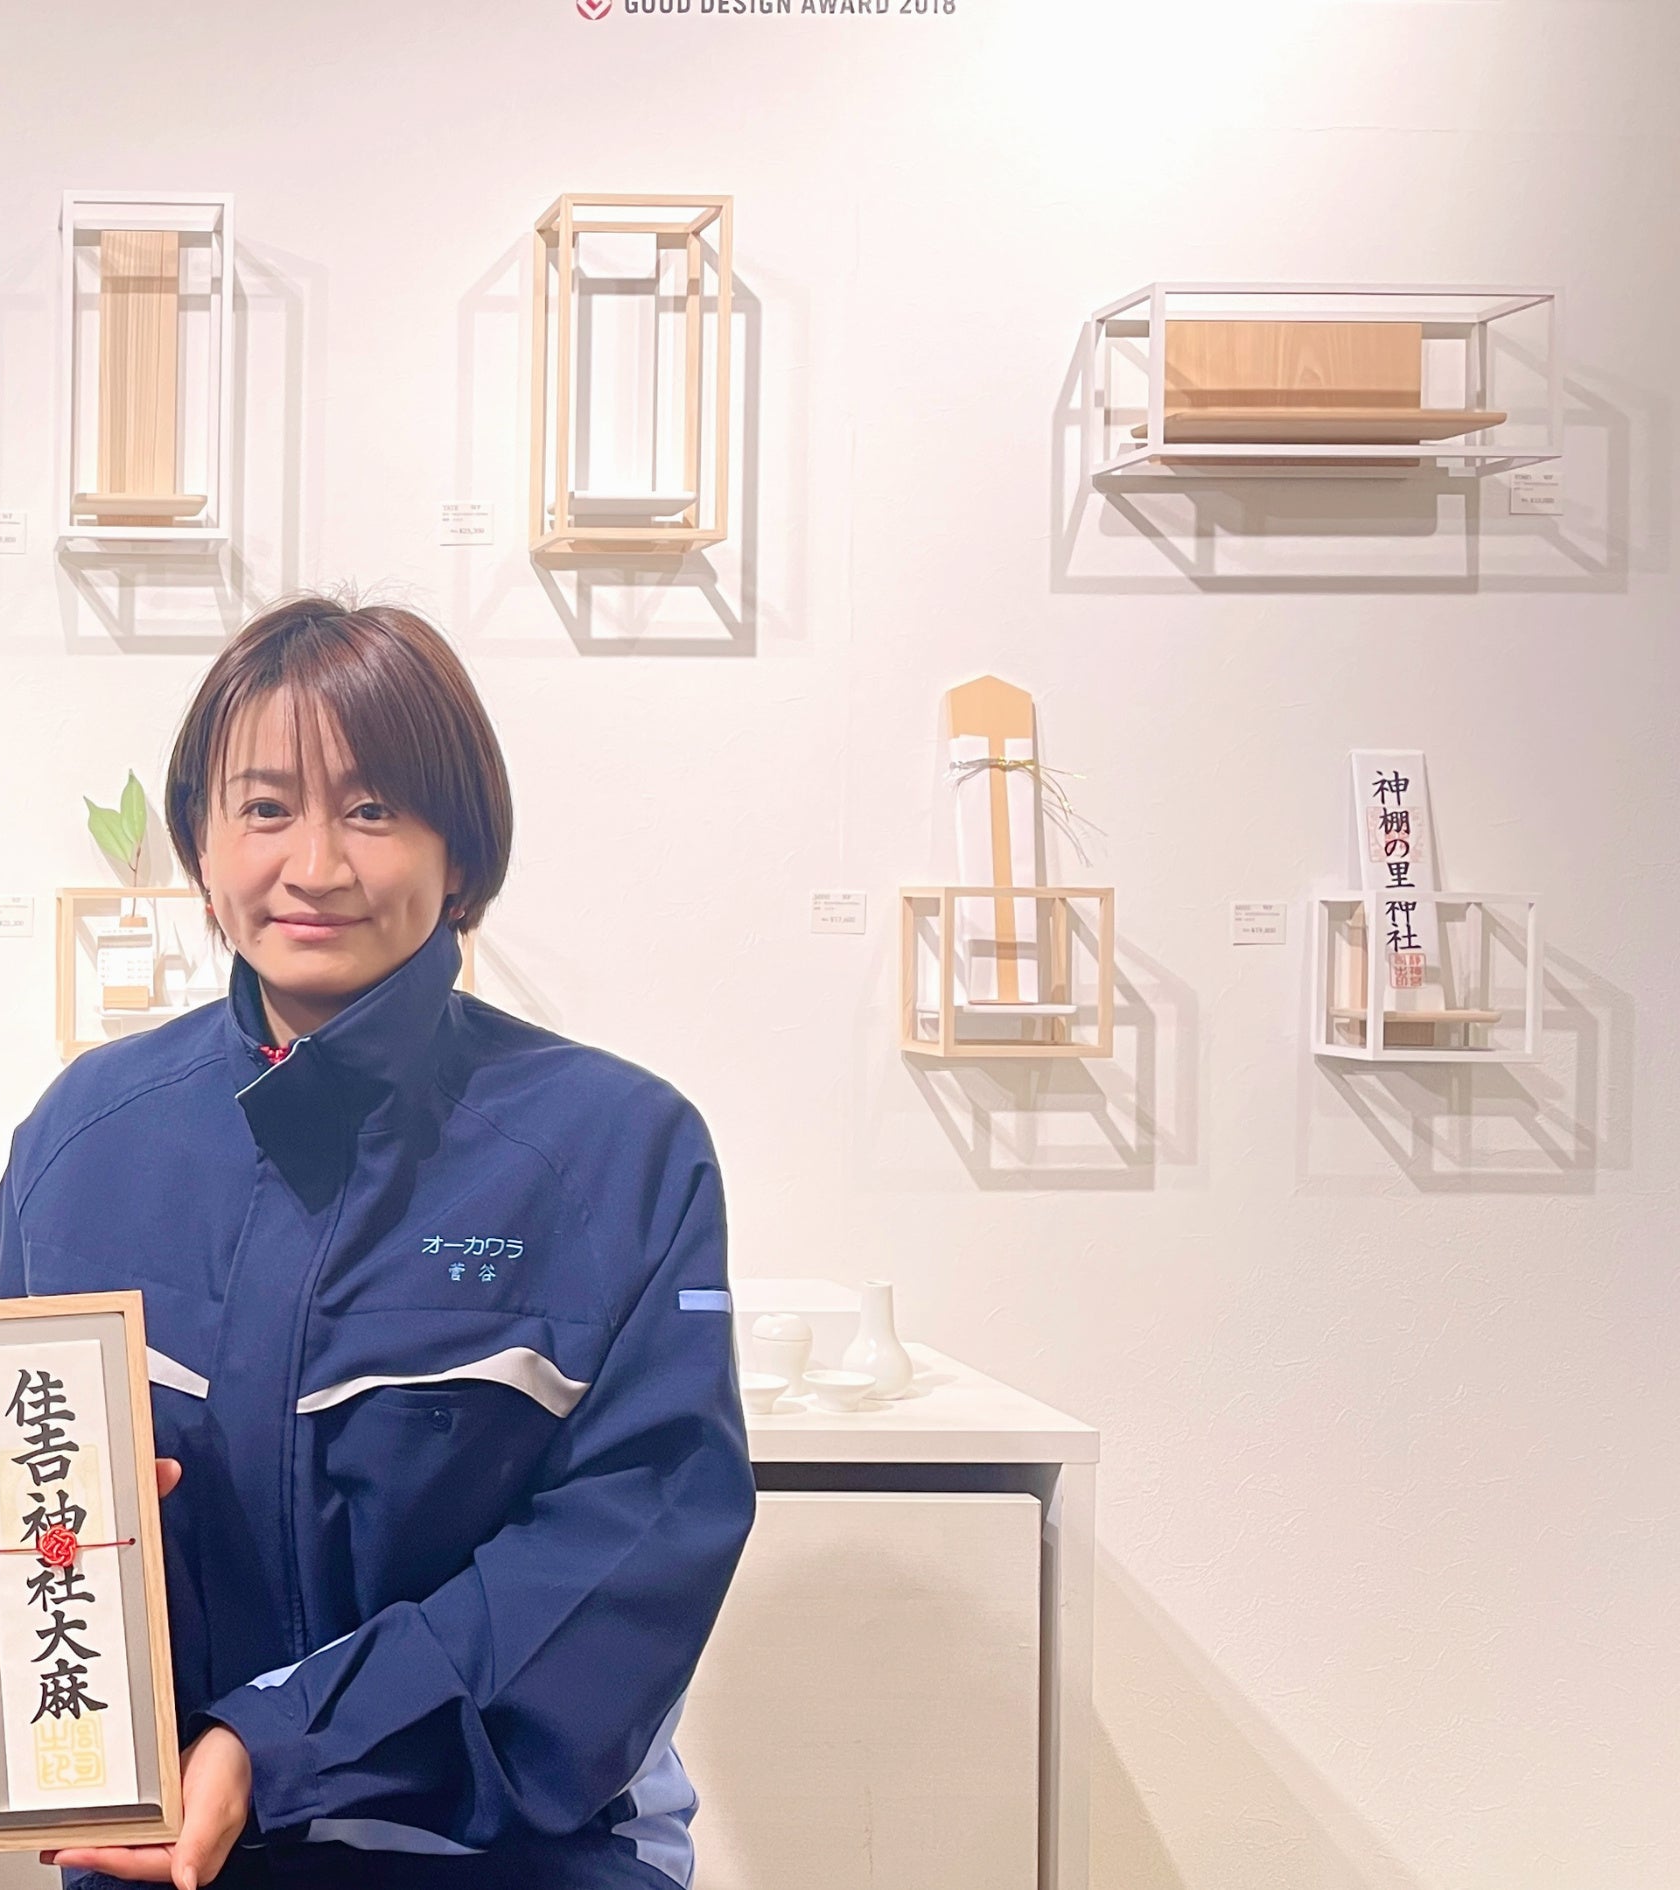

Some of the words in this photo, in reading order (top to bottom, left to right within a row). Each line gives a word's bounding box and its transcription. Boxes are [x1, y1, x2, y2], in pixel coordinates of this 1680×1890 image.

[624, 0, 691, 14] GOOD
[700, 0, 791, 14] DESIGN
[800, 0, 890, 14] AWARD
[899, 0, 957, 15] 2018
[1371, 770, 1423, 953] 神棚の里神社
[421, 1235, 524, 1258] オーカワラ
[4, 1368, 109, 1725] 住吉神社大麻
